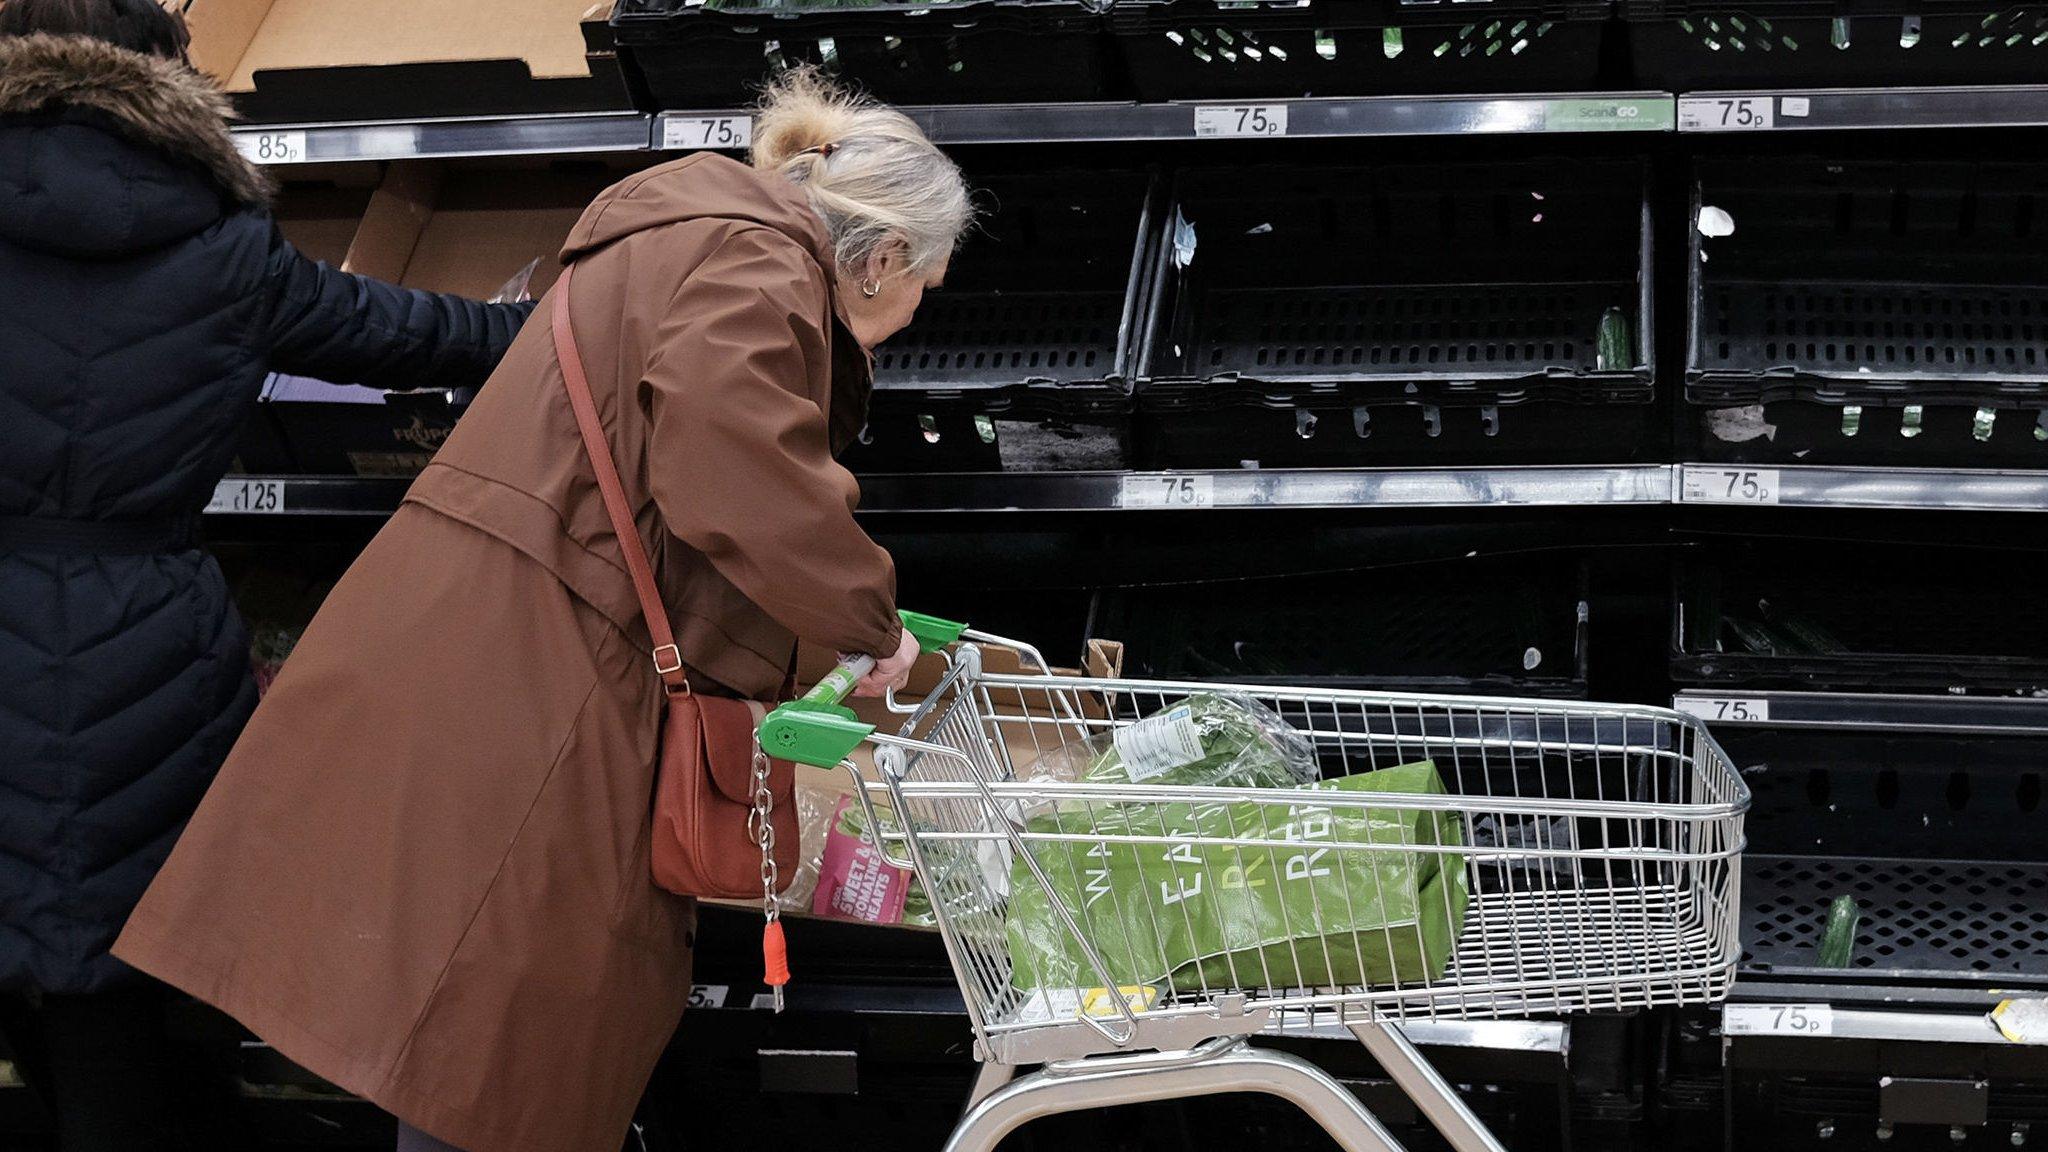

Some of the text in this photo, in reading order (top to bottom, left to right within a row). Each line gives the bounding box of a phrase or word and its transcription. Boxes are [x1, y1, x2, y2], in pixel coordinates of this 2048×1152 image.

[1234, 108, 1278, 135] 75p
[1718, 100, 1764, 128] 75p
[701, 120, 743, 147] 75p
[259, 135, 298, 161] 85p
[1161, 478, 1205, 506] 75p
[1723, 471, 1769, 501] 75p
[1713, 701, 1759, 720] 75p
[840, 860, 866, 914] SWEET
[853, 857, 882, 920] ROMAINE
[865, 873, 890, 922] HEARTS
[1769, 1006, 1820, 1033] 75p
